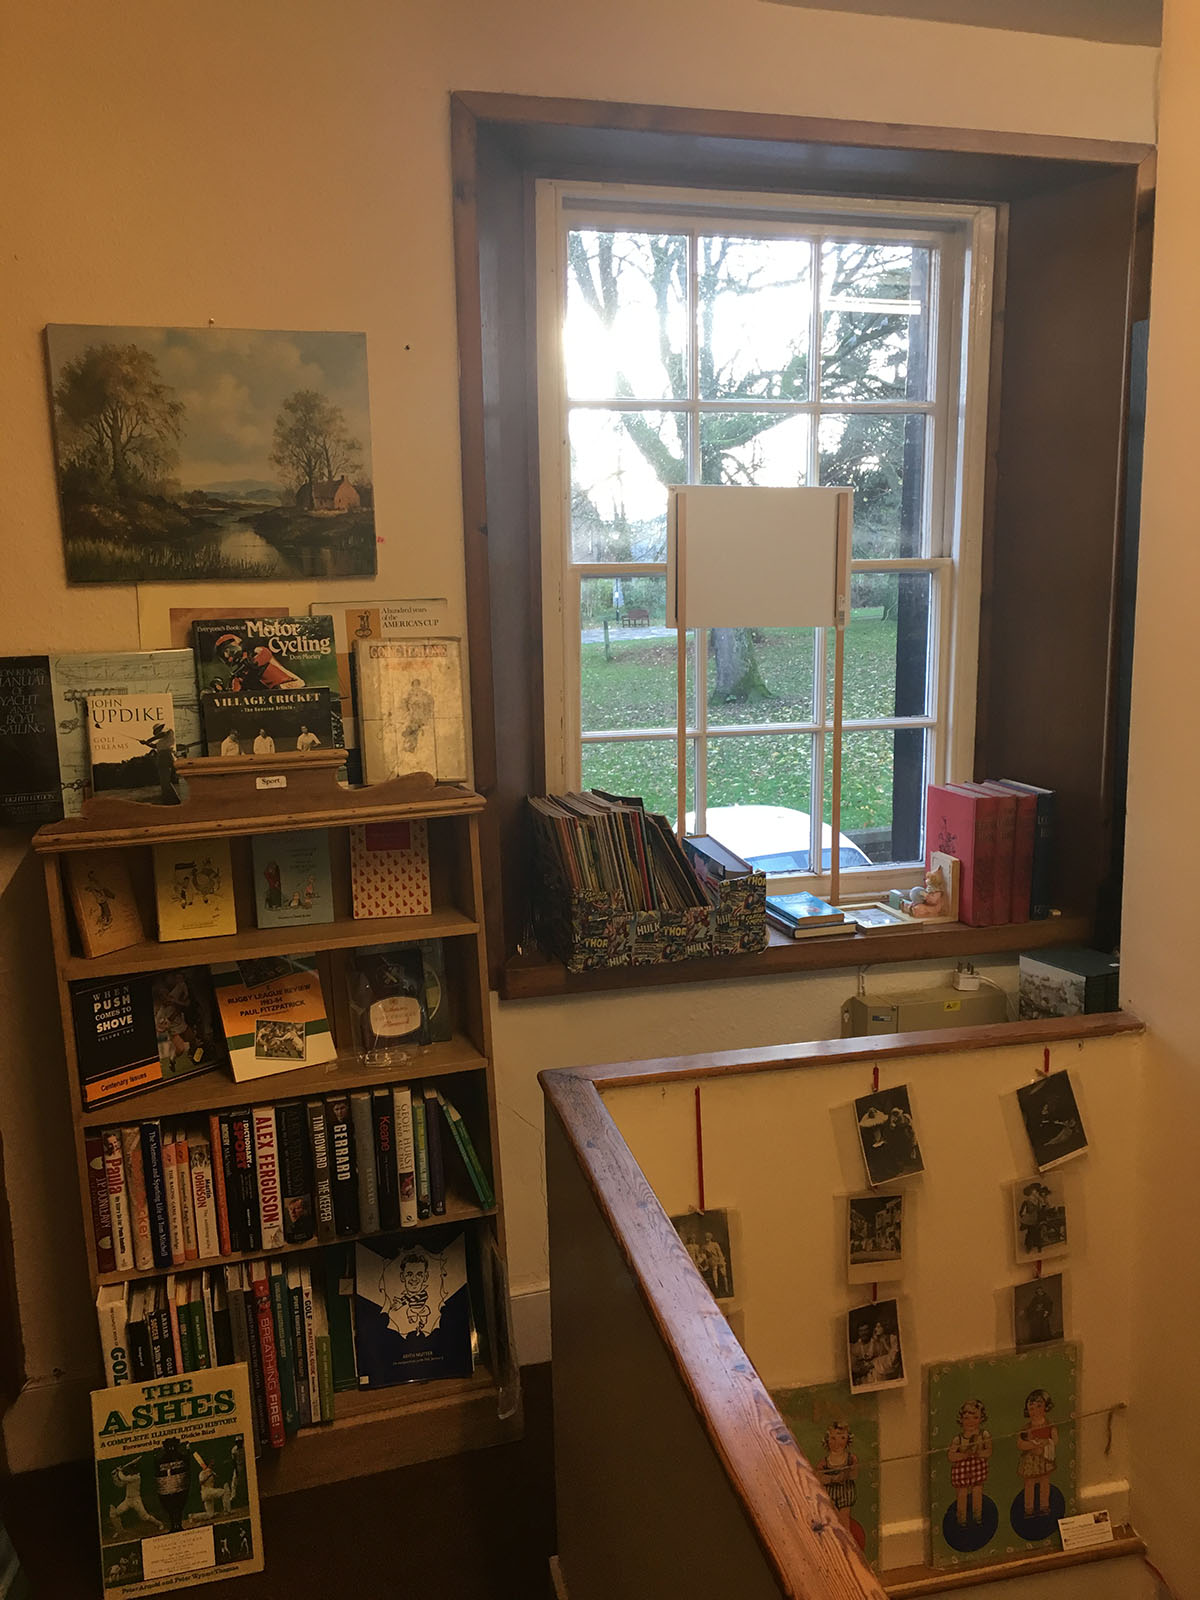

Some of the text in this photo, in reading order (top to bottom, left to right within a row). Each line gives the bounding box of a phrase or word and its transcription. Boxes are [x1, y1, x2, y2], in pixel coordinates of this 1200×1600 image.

[246, 620, 300, 638] Motor
[268, 636, 331, 657] Cycling
[0, 676, 44, 688] ANUAL
[91, 699, 122, 709] JOHN
[214, 692, 320, 707] VILLAGE CRICKET
[92, 707, 164, 724] UPDIKE
[261, 777, 280, 786] Sport
[636, 922, 660, 936] HULK
[687, 942, 710, 954] HULK
[92, 986, 129, 1002] WHEN
[94, 994, 131, 1012] PUSH
[227, 984, 311, 1004] RUGBY LEAGUE REVIEW
[95, 1006, 132, 1022] COMES TO
[240, 1008, 260, 1016] PAUL
[260, 1000, 306, 1013] FITZPATRICK
[96, 1014, 134, 1033] SHOVE
[100, 1072, 147, 1092] Centenary Issues
[148, 1131, 156, 1142] The
[243, 1123, 252, 1164] DICTIONARY
[312, 1115, 328, 1168] TIM HOWARD
[378, 1115, 392, 1152] Keane
[400, 1104, 413, 1169] GEOFF HURST
[232, 1121, 247, 1168] SPORT
[333, 1124, 351, 1181] GERRARD
[106, 1158, 124, 1194] Paula
[152, 1168, 160, 1178] and
[255, 1117, 280, 1222] ALEX FERGUSON
[152, 1178, 163, 1202] Sporting
[194, 1171, 207, 1208] JOHNSON
[97, 1190, 110, 1228] DONLEAVY
[156, 1203, 164, 1214] Life
[318, 1179, 332, 1222] THE KEEPER
[304, 1300, 312, 1319] GOLF
[150, 1318, 160, 1341] SOCCER
[110, 1347, 128, 1386] GOL
[260, 1318, 276, 1390] BREATHING
[270, 1394, 280, 1428] FIRE!
[142, 1380, 192, 1400] THE
[98, 1390, 236, 1437] ASHES
[107, 1434, 150, 1446] COMPLETE
[151, 1423, 204, 1438] ILLUSTRATED
[204, 1417, 238, 1428] HISTORY
[122, 1428, 216, 1450] Foreword by Dickie Bird
[174, 1575, 191, 1584] Peter
